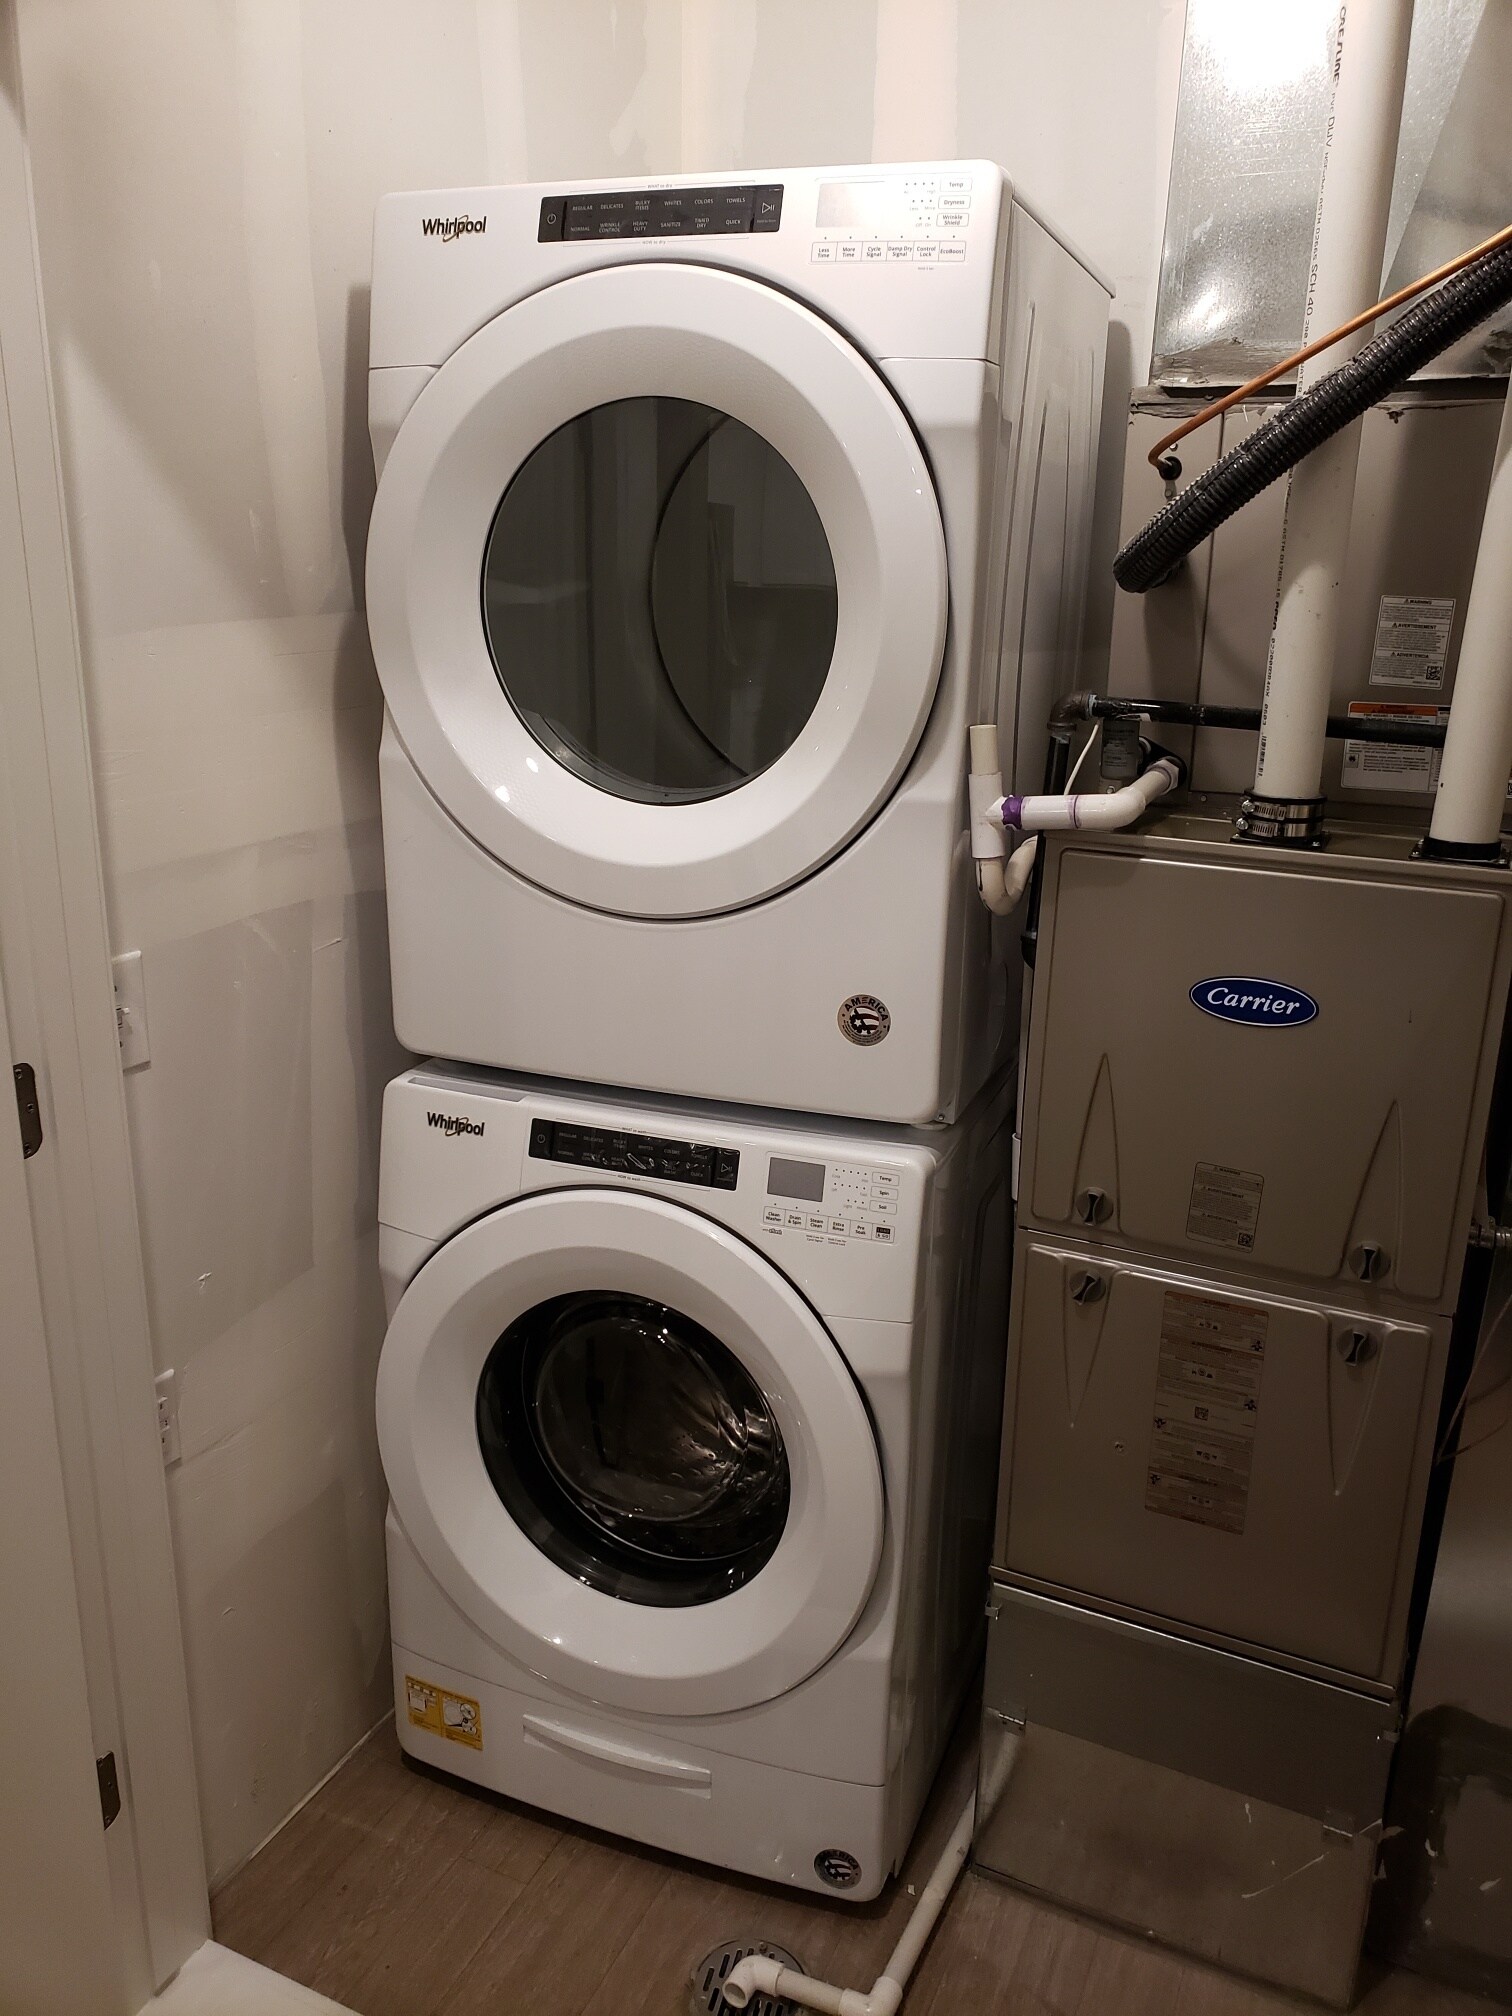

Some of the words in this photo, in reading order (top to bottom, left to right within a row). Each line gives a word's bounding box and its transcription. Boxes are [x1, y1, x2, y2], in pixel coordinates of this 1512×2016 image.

[422, 215, 487, 241] Whirlpool
[1308, 264, 1318, 293] SCH
[1306, 297, 1314, 316] 40
[844, 997, 889, 1022] AMERICA
[1207, 987, 1300, 1015] Carrier
[427, 1112, 486, 1137] Whirlpool
